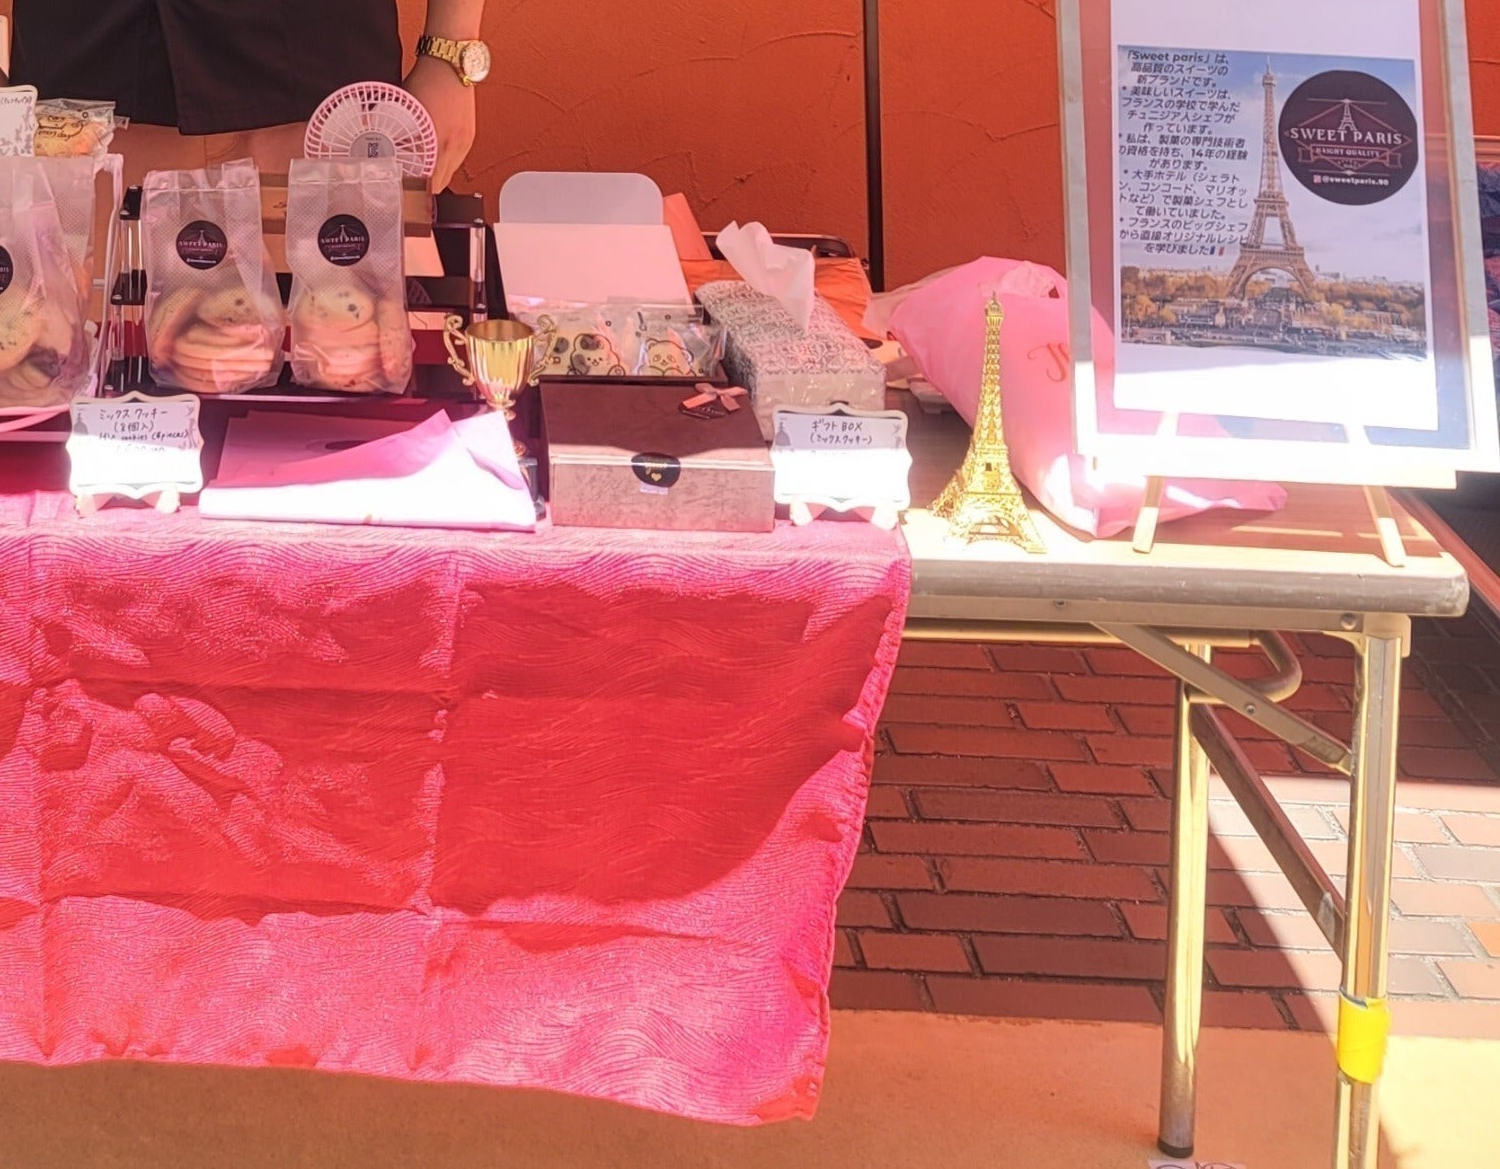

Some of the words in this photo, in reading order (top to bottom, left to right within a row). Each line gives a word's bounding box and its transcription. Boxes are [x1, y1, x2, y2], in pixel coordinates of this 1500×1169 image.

[1130, 62, 1229, 76] 高品質のスイーツの
[1137, 74, 1216, 88] 新ブランドです。
[1121, 97, 1241, 112] フランスの学校で学んだ
[1127, 110, 1235, 124] チュニジア人シェフが
[1143, 122, 1212, 135] 作っています。
[1290, 127, 1348, 142] SWEET
[1353, 131, 1402, 144] PARIS
[1148, 158, 1208, 171] があります。
[1135, 205, 1226, 220] て働いていました。
[812, 419, 837, 431] ギフト
[841, 422, 864, 431] BOX
